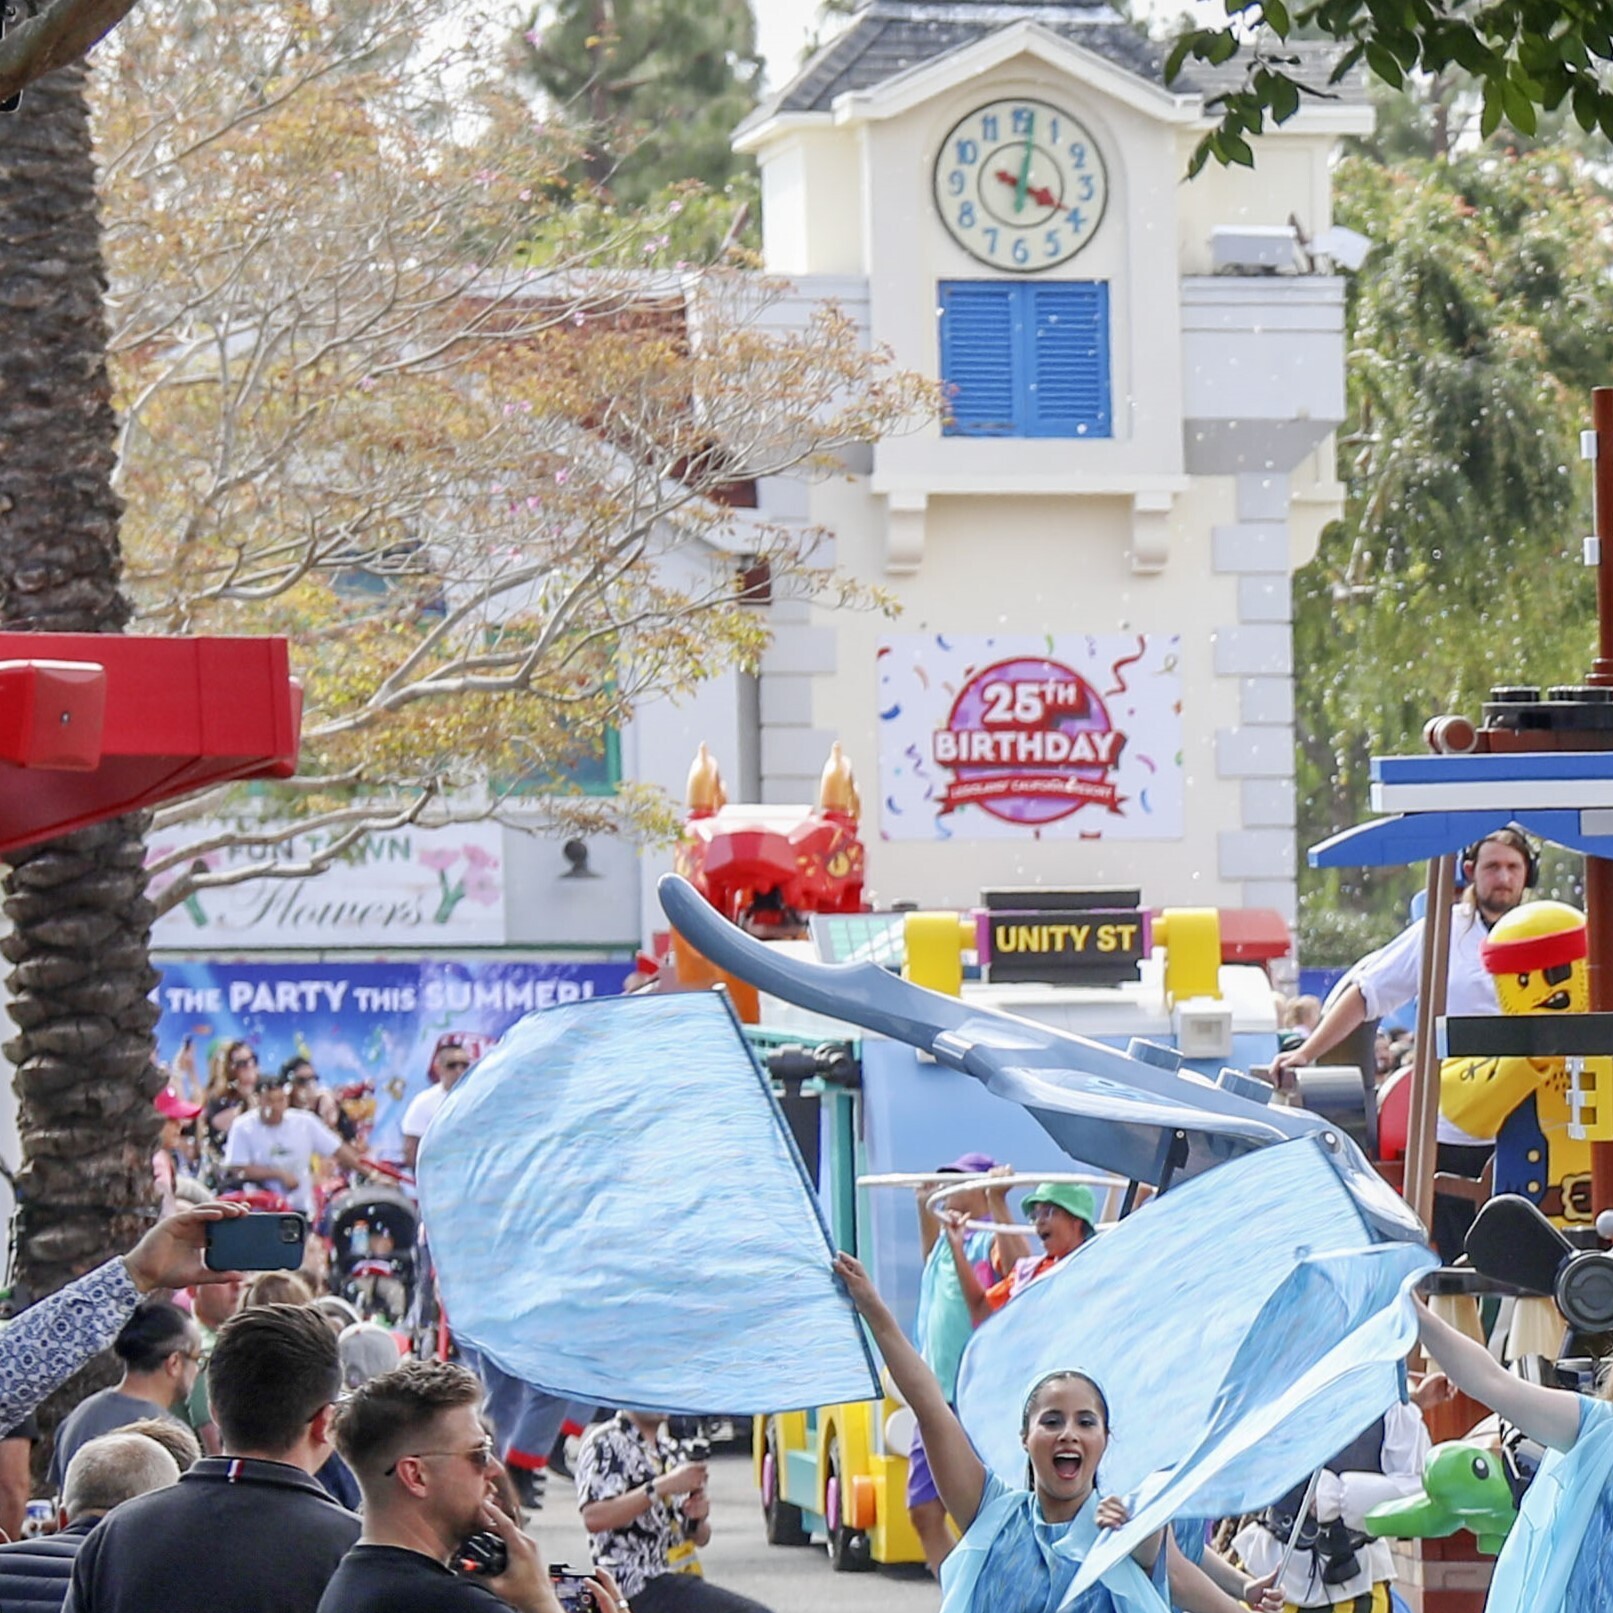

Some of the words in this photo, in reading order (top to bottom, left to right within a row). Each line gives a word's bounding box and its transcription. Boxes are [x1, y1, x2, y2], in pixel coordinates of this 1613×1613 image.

[981, 113, 998, 142] 11
[956, 139, 978, 165] 10
[1069, 142, 1086, 169] 2
[949, 170, 965, 196] 9
[1078, 174, 1094, 202] 3
[957, 200, 975, 229] 8
[1065, 206, 1087, 234] 4
[983, 227, 998, 254] 7
[1012, 237, 1029, 265] 6
[1044, 228, 1061, 258] 5
[934, 730, 1116, 762] BIRTHDAY
[996, 924, 1091, 953] UNITY
[1096, 924, 1138, 953] ST
[164, 988, 222, 1013] THE
[229, 980, 348, 1013] PARTY
[353, 987, 417, 1012] THIS
